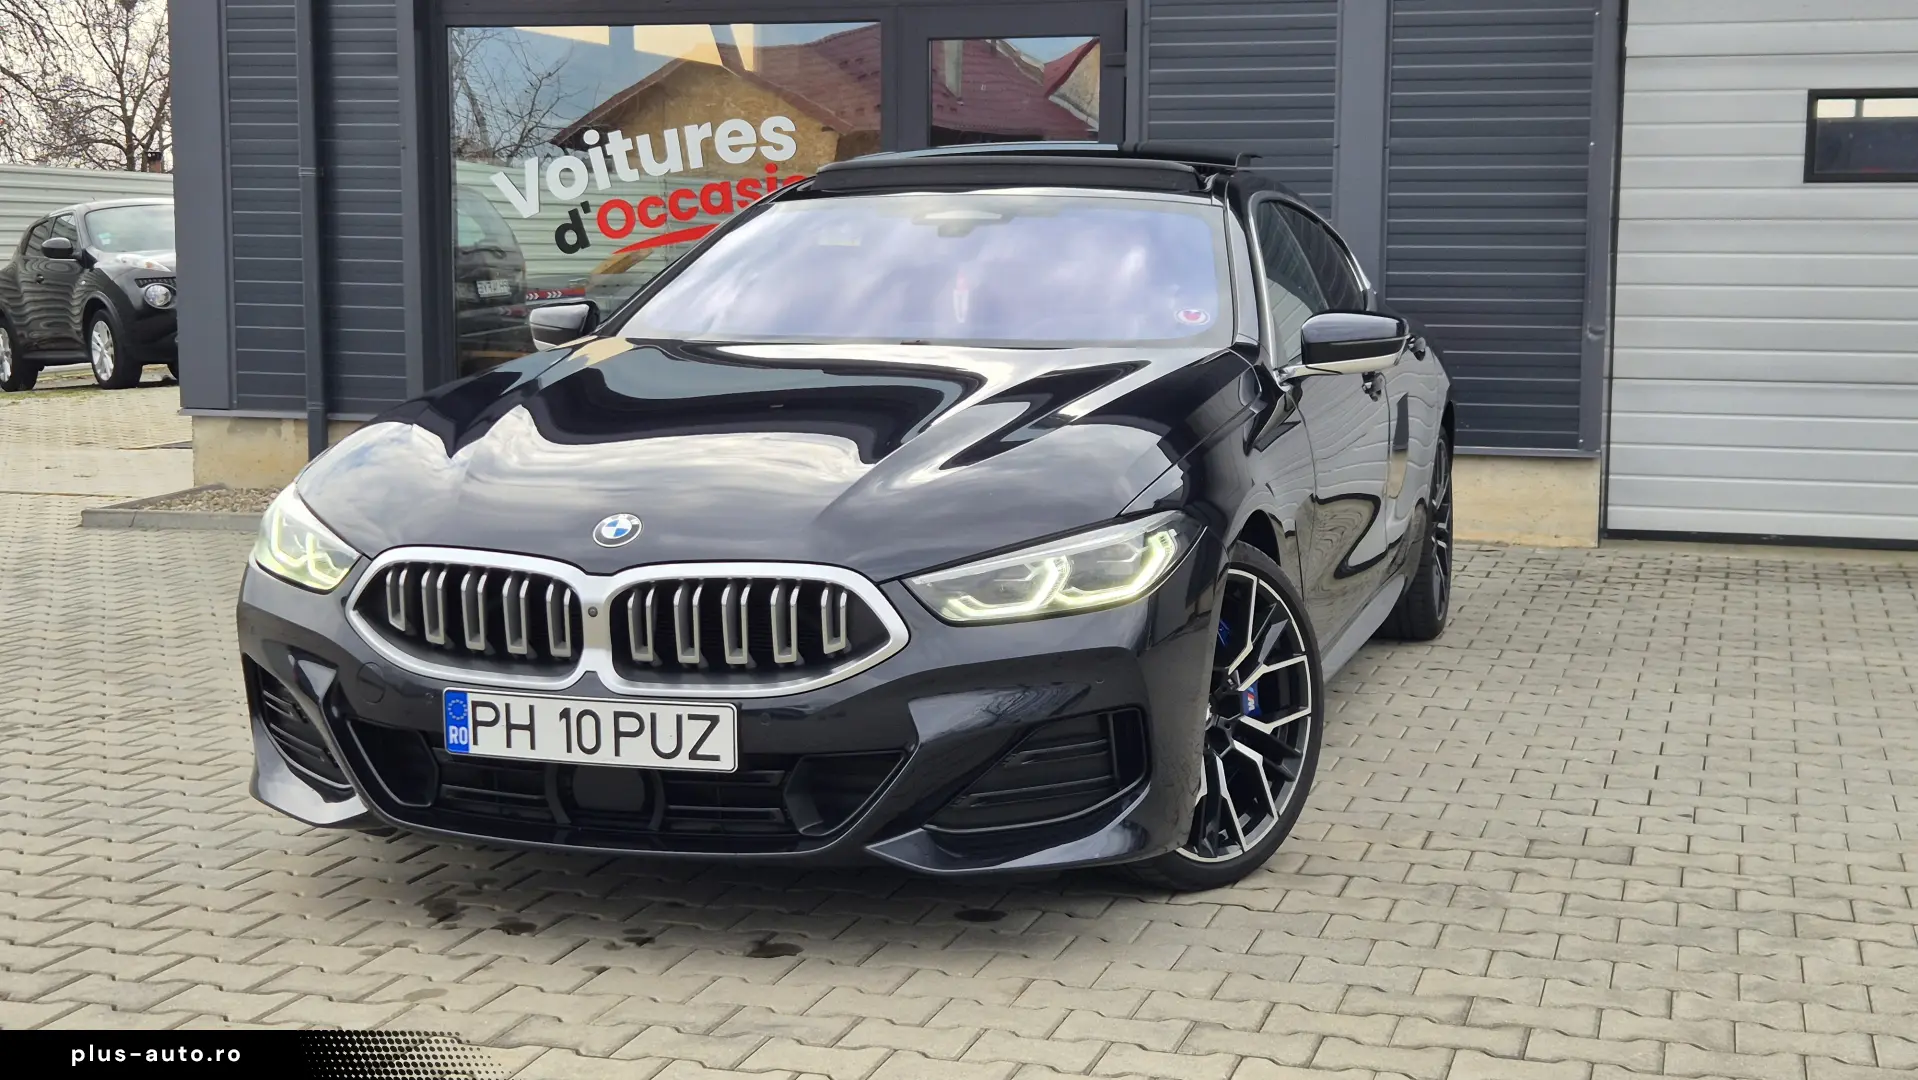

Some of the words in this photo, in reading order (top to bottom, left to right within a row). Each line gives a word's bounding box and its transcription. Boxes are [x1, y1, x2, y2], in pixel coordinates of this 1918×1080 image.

[489, 115, 797, 219] Voitures
[449, 725, 468, 745] RO
[470, 700, 536, 750] PH
[559, 707, 602, 755] 10
[613, 710, 721, 762] PUZ
